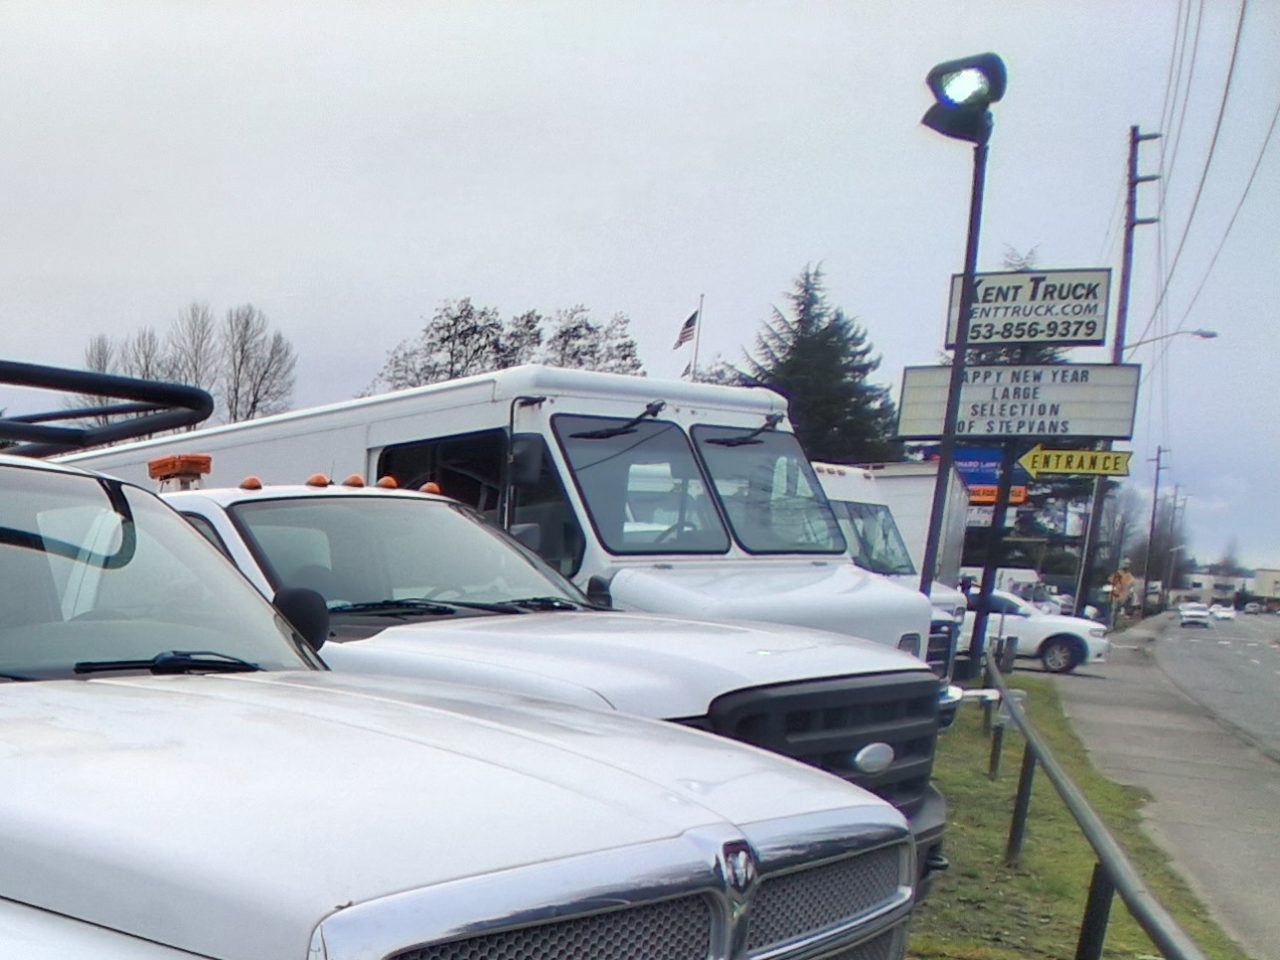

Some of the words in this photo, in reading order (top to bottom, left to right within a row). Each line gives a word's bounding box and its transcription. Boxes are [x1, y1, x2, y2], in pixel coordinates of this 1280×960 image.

[1029, 276, 1101, 301] TRUCK
[970, 303, 1098, 320] ENTTRUCK.COM
[970, 320, 1097, 340] 53-856-9379
[962, 370, 1002, 384] APPY
[1011, 370, 1042, 383] NEW
[1051, 369, 1089, 383] YEAR
[992, 386, 1040, 400] LARGE
[971, 403, 1060, 417] SELECTION
[957, 420, 975, 433] OF
[986, 420, 1069, 433] STEPVANS
[1031, 453, 1121, 471] ENTRANCE
